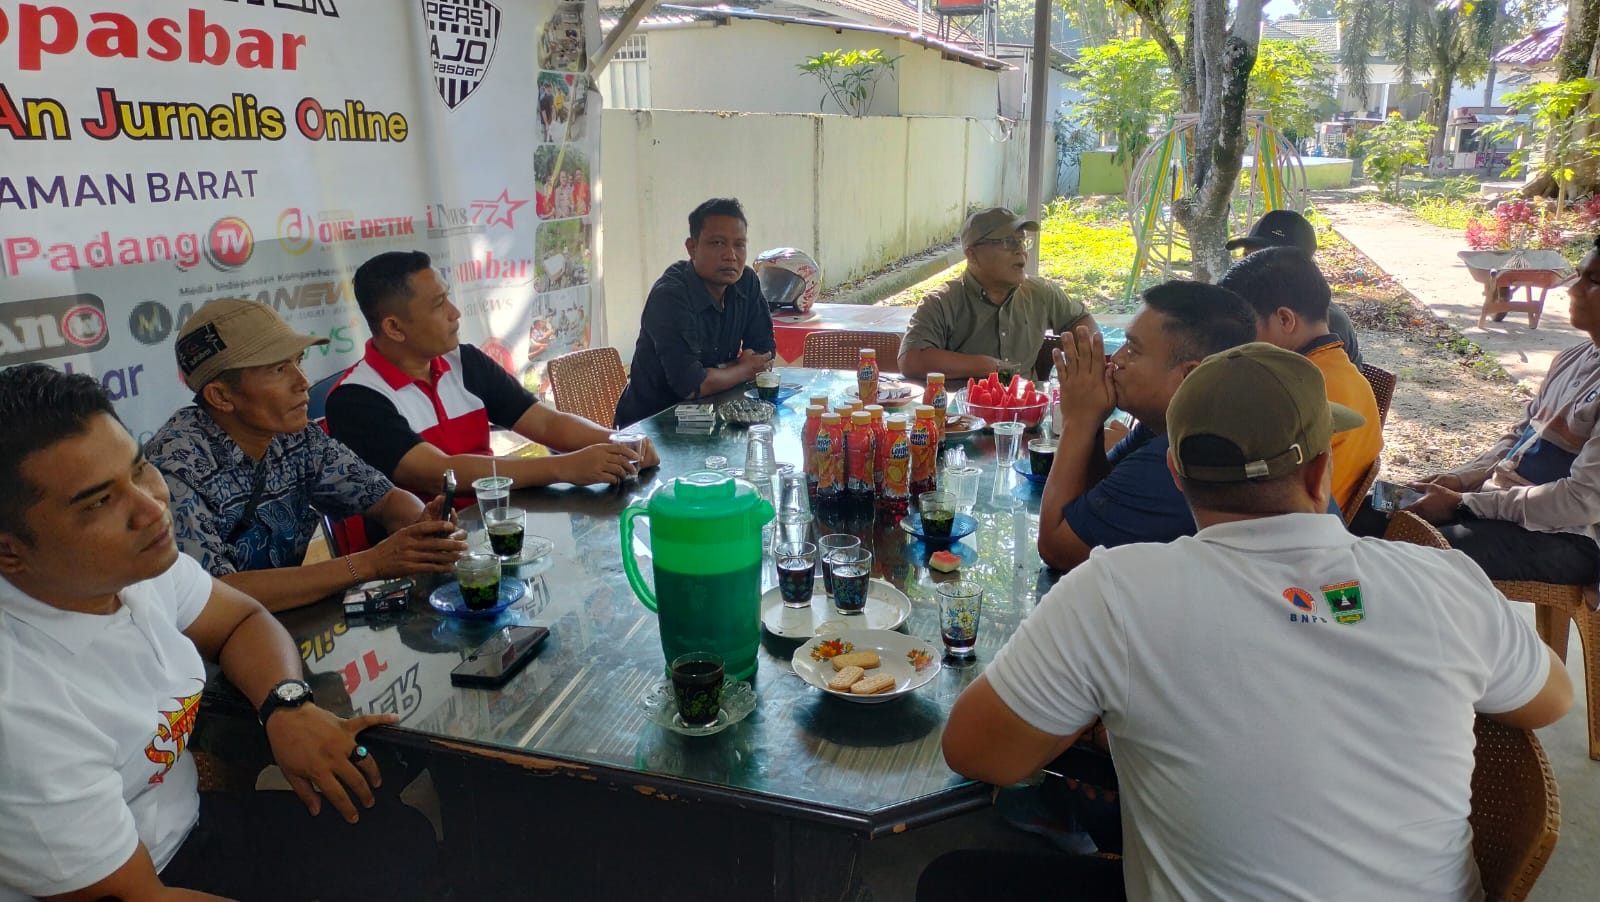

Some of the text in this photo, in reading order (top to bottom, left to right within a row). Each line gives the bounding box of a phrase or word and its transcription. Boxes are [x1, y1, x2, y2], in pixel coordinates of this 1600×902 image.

[0, 4, 306, 71] pasbar
[430, 35, 488, 64] AJO
[434, 61, 483, 77] Pasbar
[81, 87, 286, 141] Jurnalis
[295, 96, 409, 143] Online
[146, 170, 258, 203] BARAT
[318, 220, 356, 243] ONE
[360, 216, 415, 239] DETIK
[4, 228, 247, 276] Padang TV
